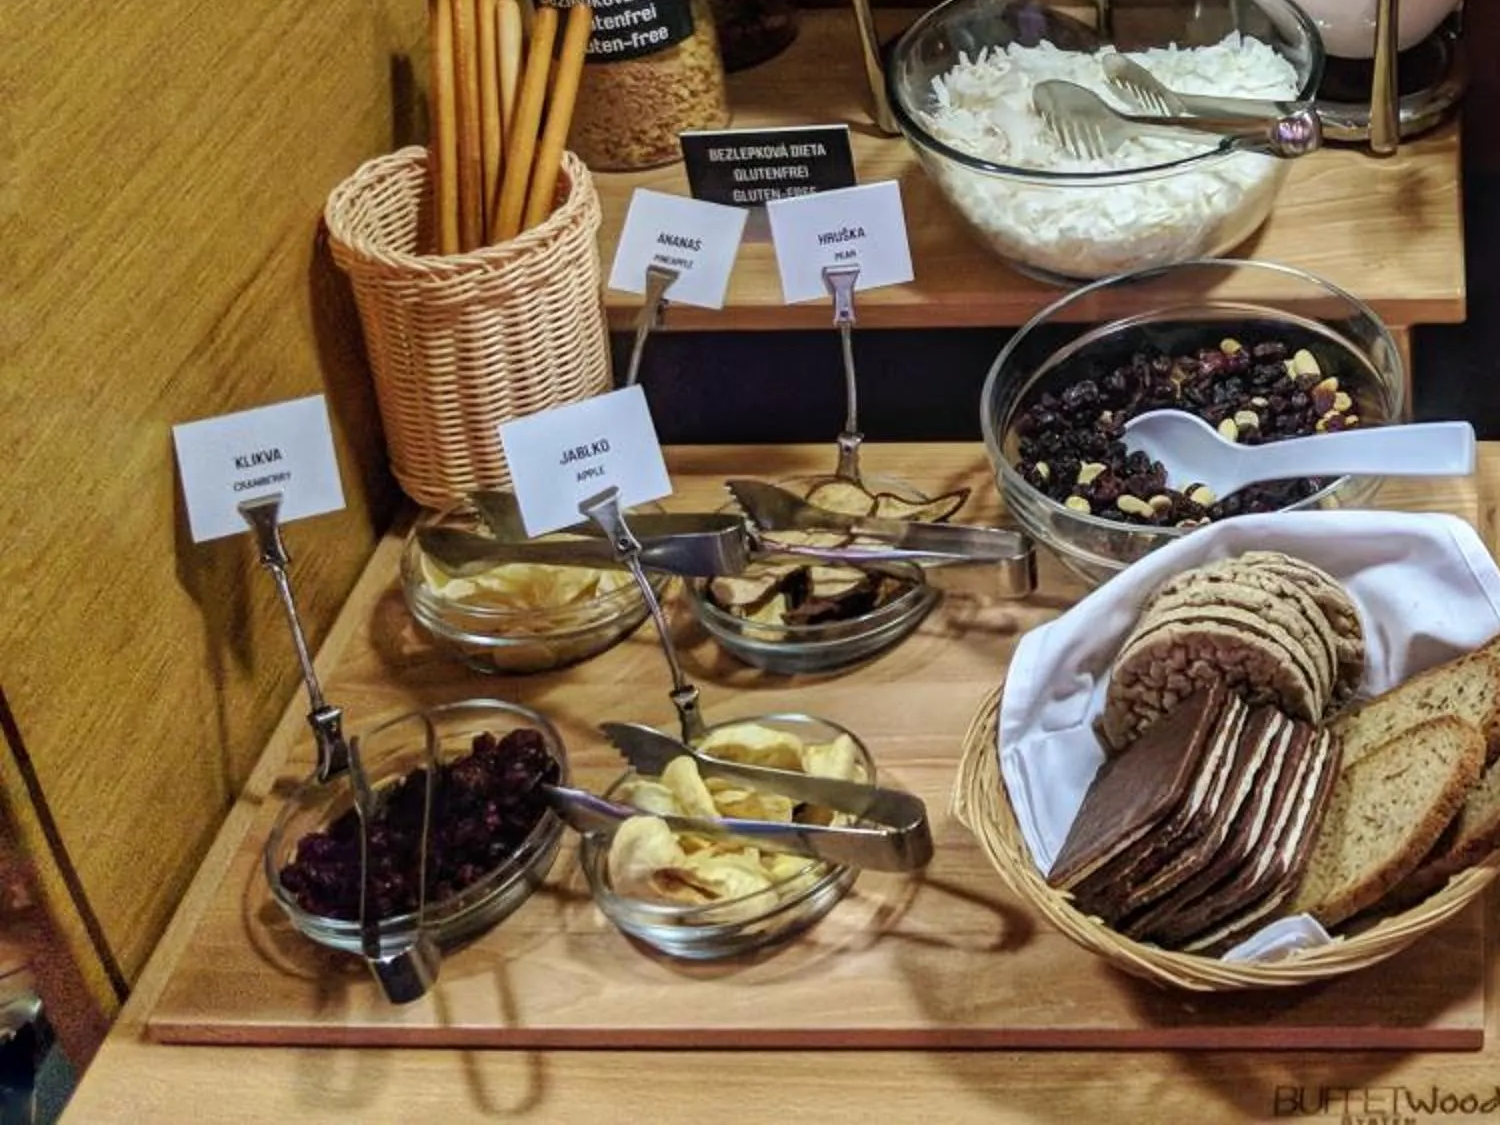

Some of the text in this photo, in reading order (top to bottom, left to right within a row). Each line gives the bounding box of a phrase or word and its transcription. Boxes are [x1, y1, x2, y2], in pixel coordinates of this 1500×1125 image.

[790, 143, 827, 158] DIETA
[733, 165, 809, 182] GLUTENFREI
[816, 227, 866, 246] HRUŠKA
[235, 448, 283, 470] KLIKVA
[559, 438, 611, 465] JABLKO
[576, 466, 605, 482] APPLE
